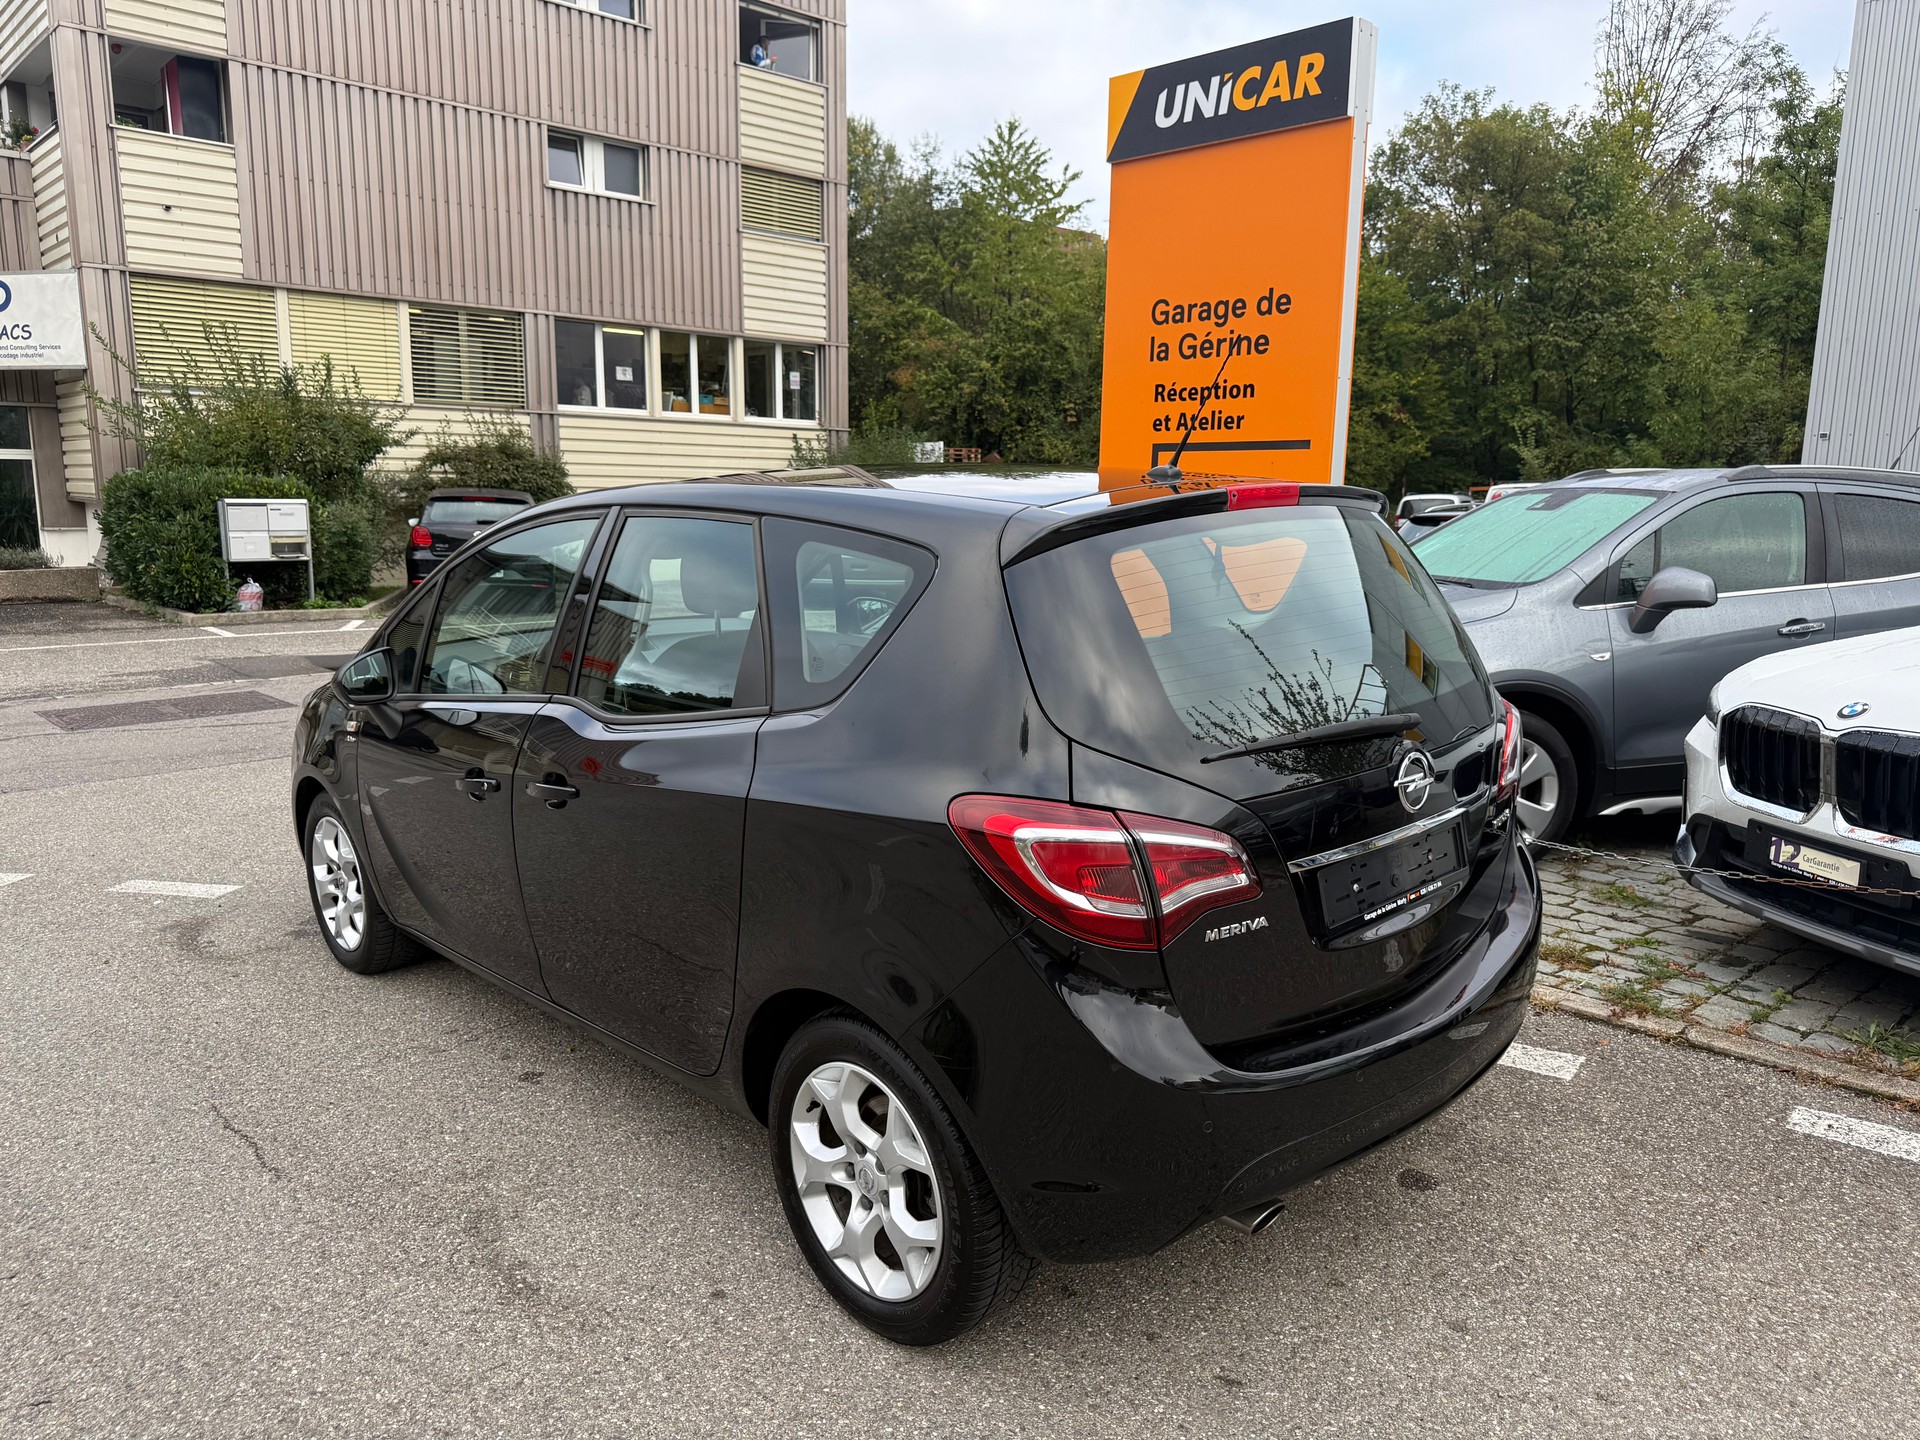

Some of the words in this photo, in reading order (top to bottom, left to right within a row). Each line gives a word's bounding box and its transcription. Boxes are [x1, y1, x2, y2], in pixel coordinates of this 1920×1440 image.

[1151, 297, 1247, 327] Garage
[1256, 287, 1292, 316] de
[10, 344, 38, 352] Consulting
[1149, 336, 1170, 362] la
[1178, 329, 1271, 360] Gérine
[1153, 378, 1256, 406] Réception
[1152, 414, 1171, 432] et
[1175, 409, 1245, 431] Atelier
[1802, 854, 1840, 873] CarGarantie
[1204, 916, 1269, 943] MERIVA
